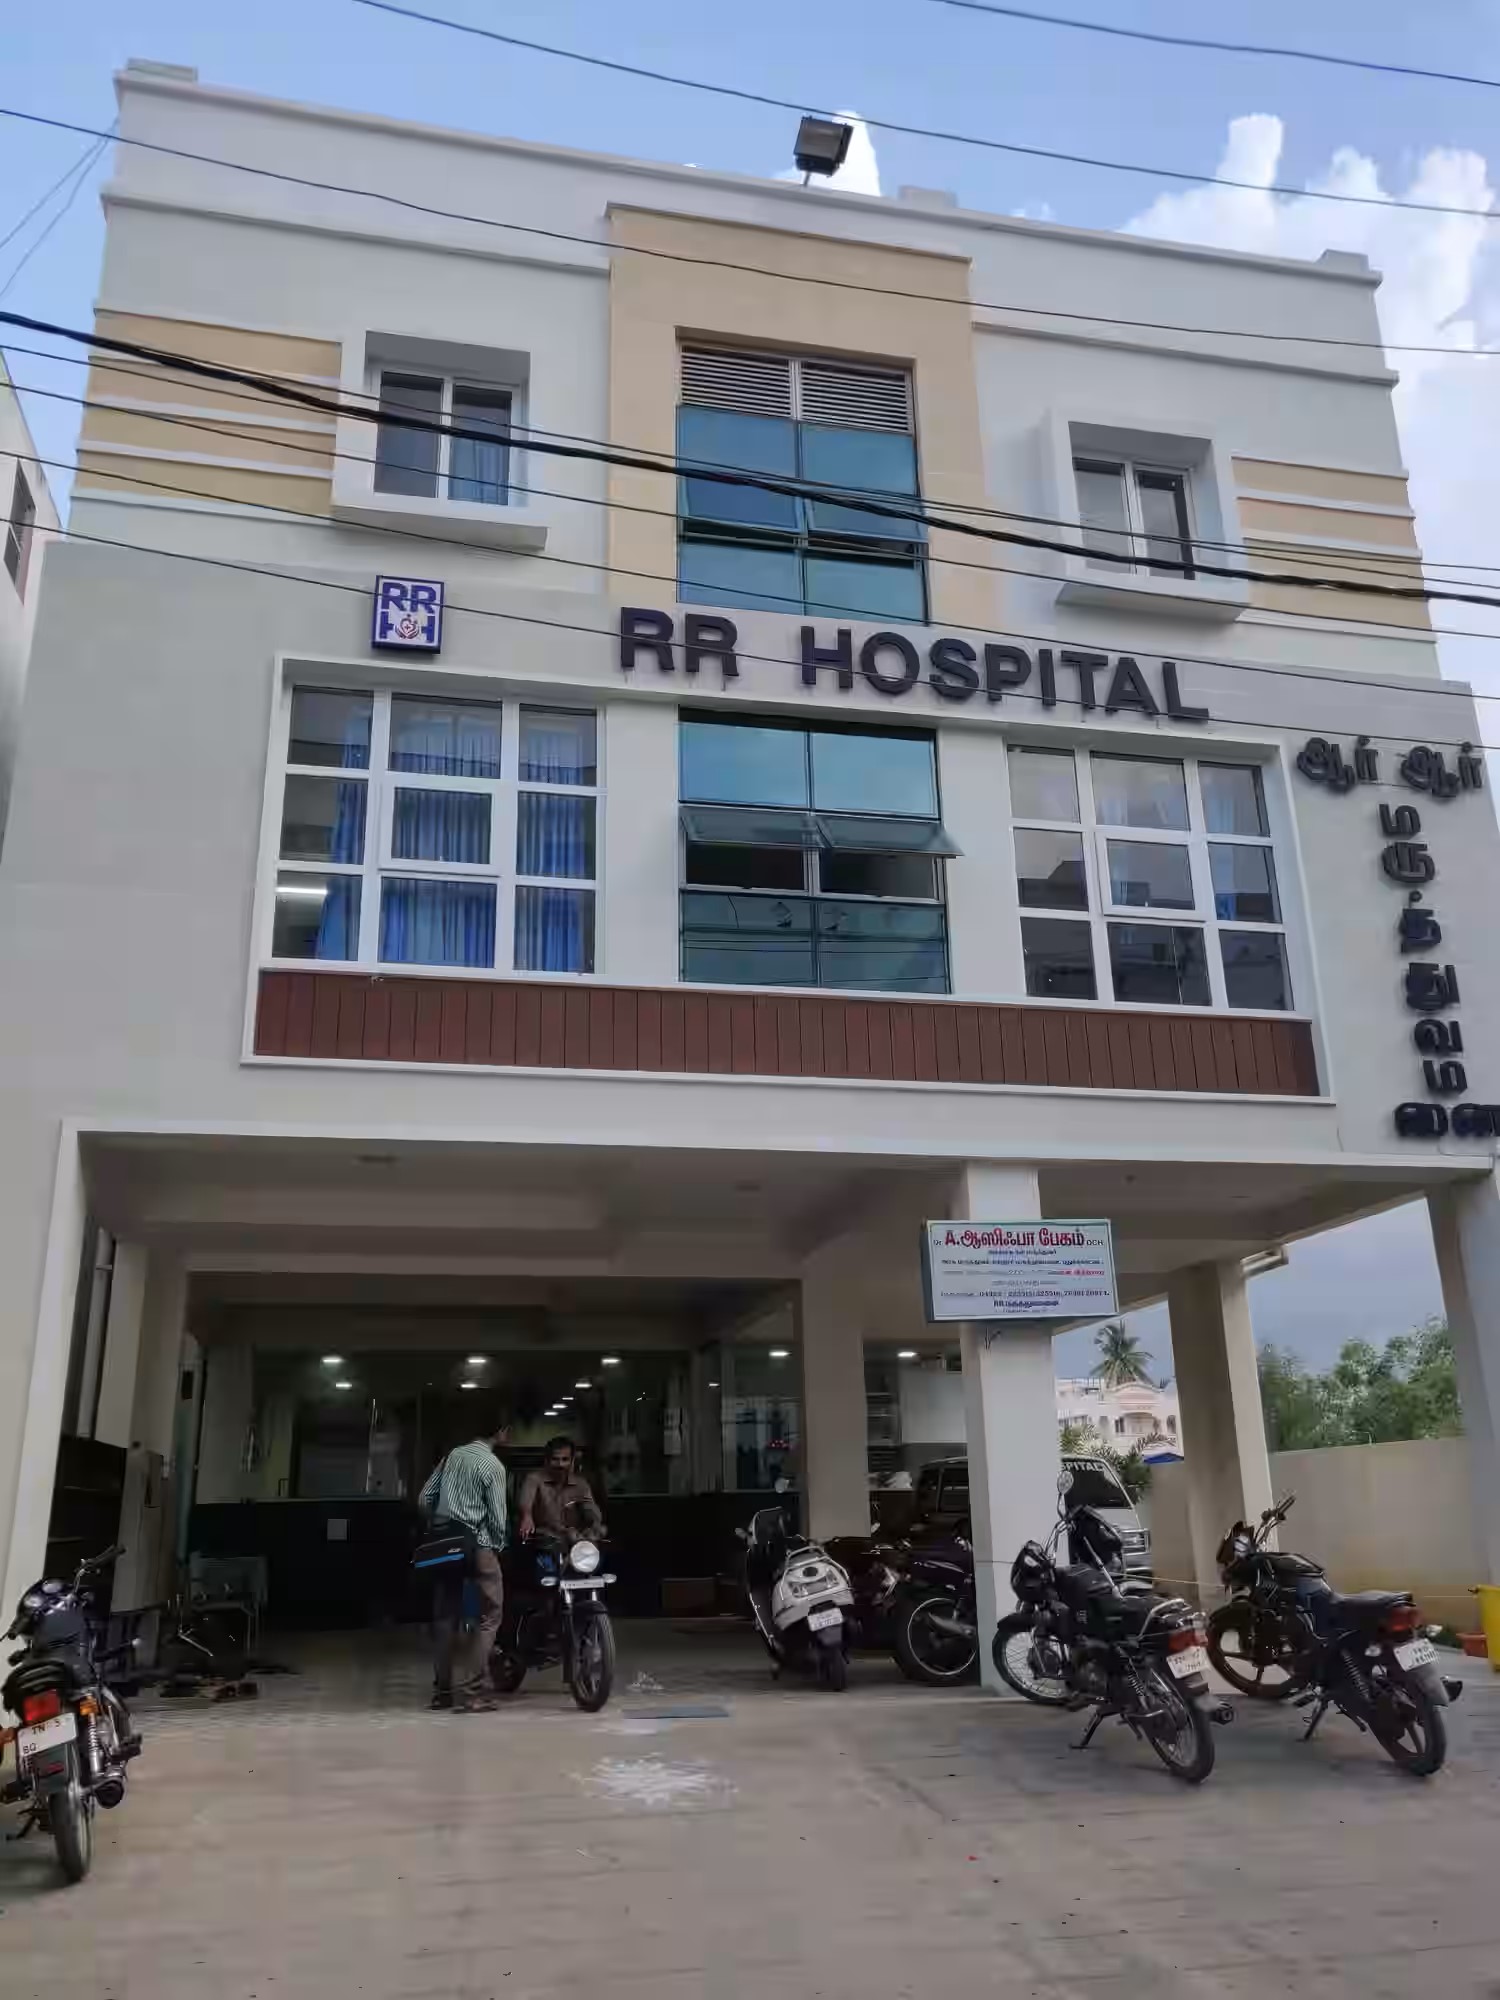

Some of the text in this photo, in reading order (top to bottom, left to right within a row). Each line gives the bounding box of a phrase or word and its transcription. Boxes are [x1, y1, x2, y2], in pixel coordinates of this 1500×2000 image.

[381, 582, 436, 613] RR
[619, 607, 1210, 721] RR HOSPITAL
[1297, 735, 1484, 798] ஆர் ஆர்
